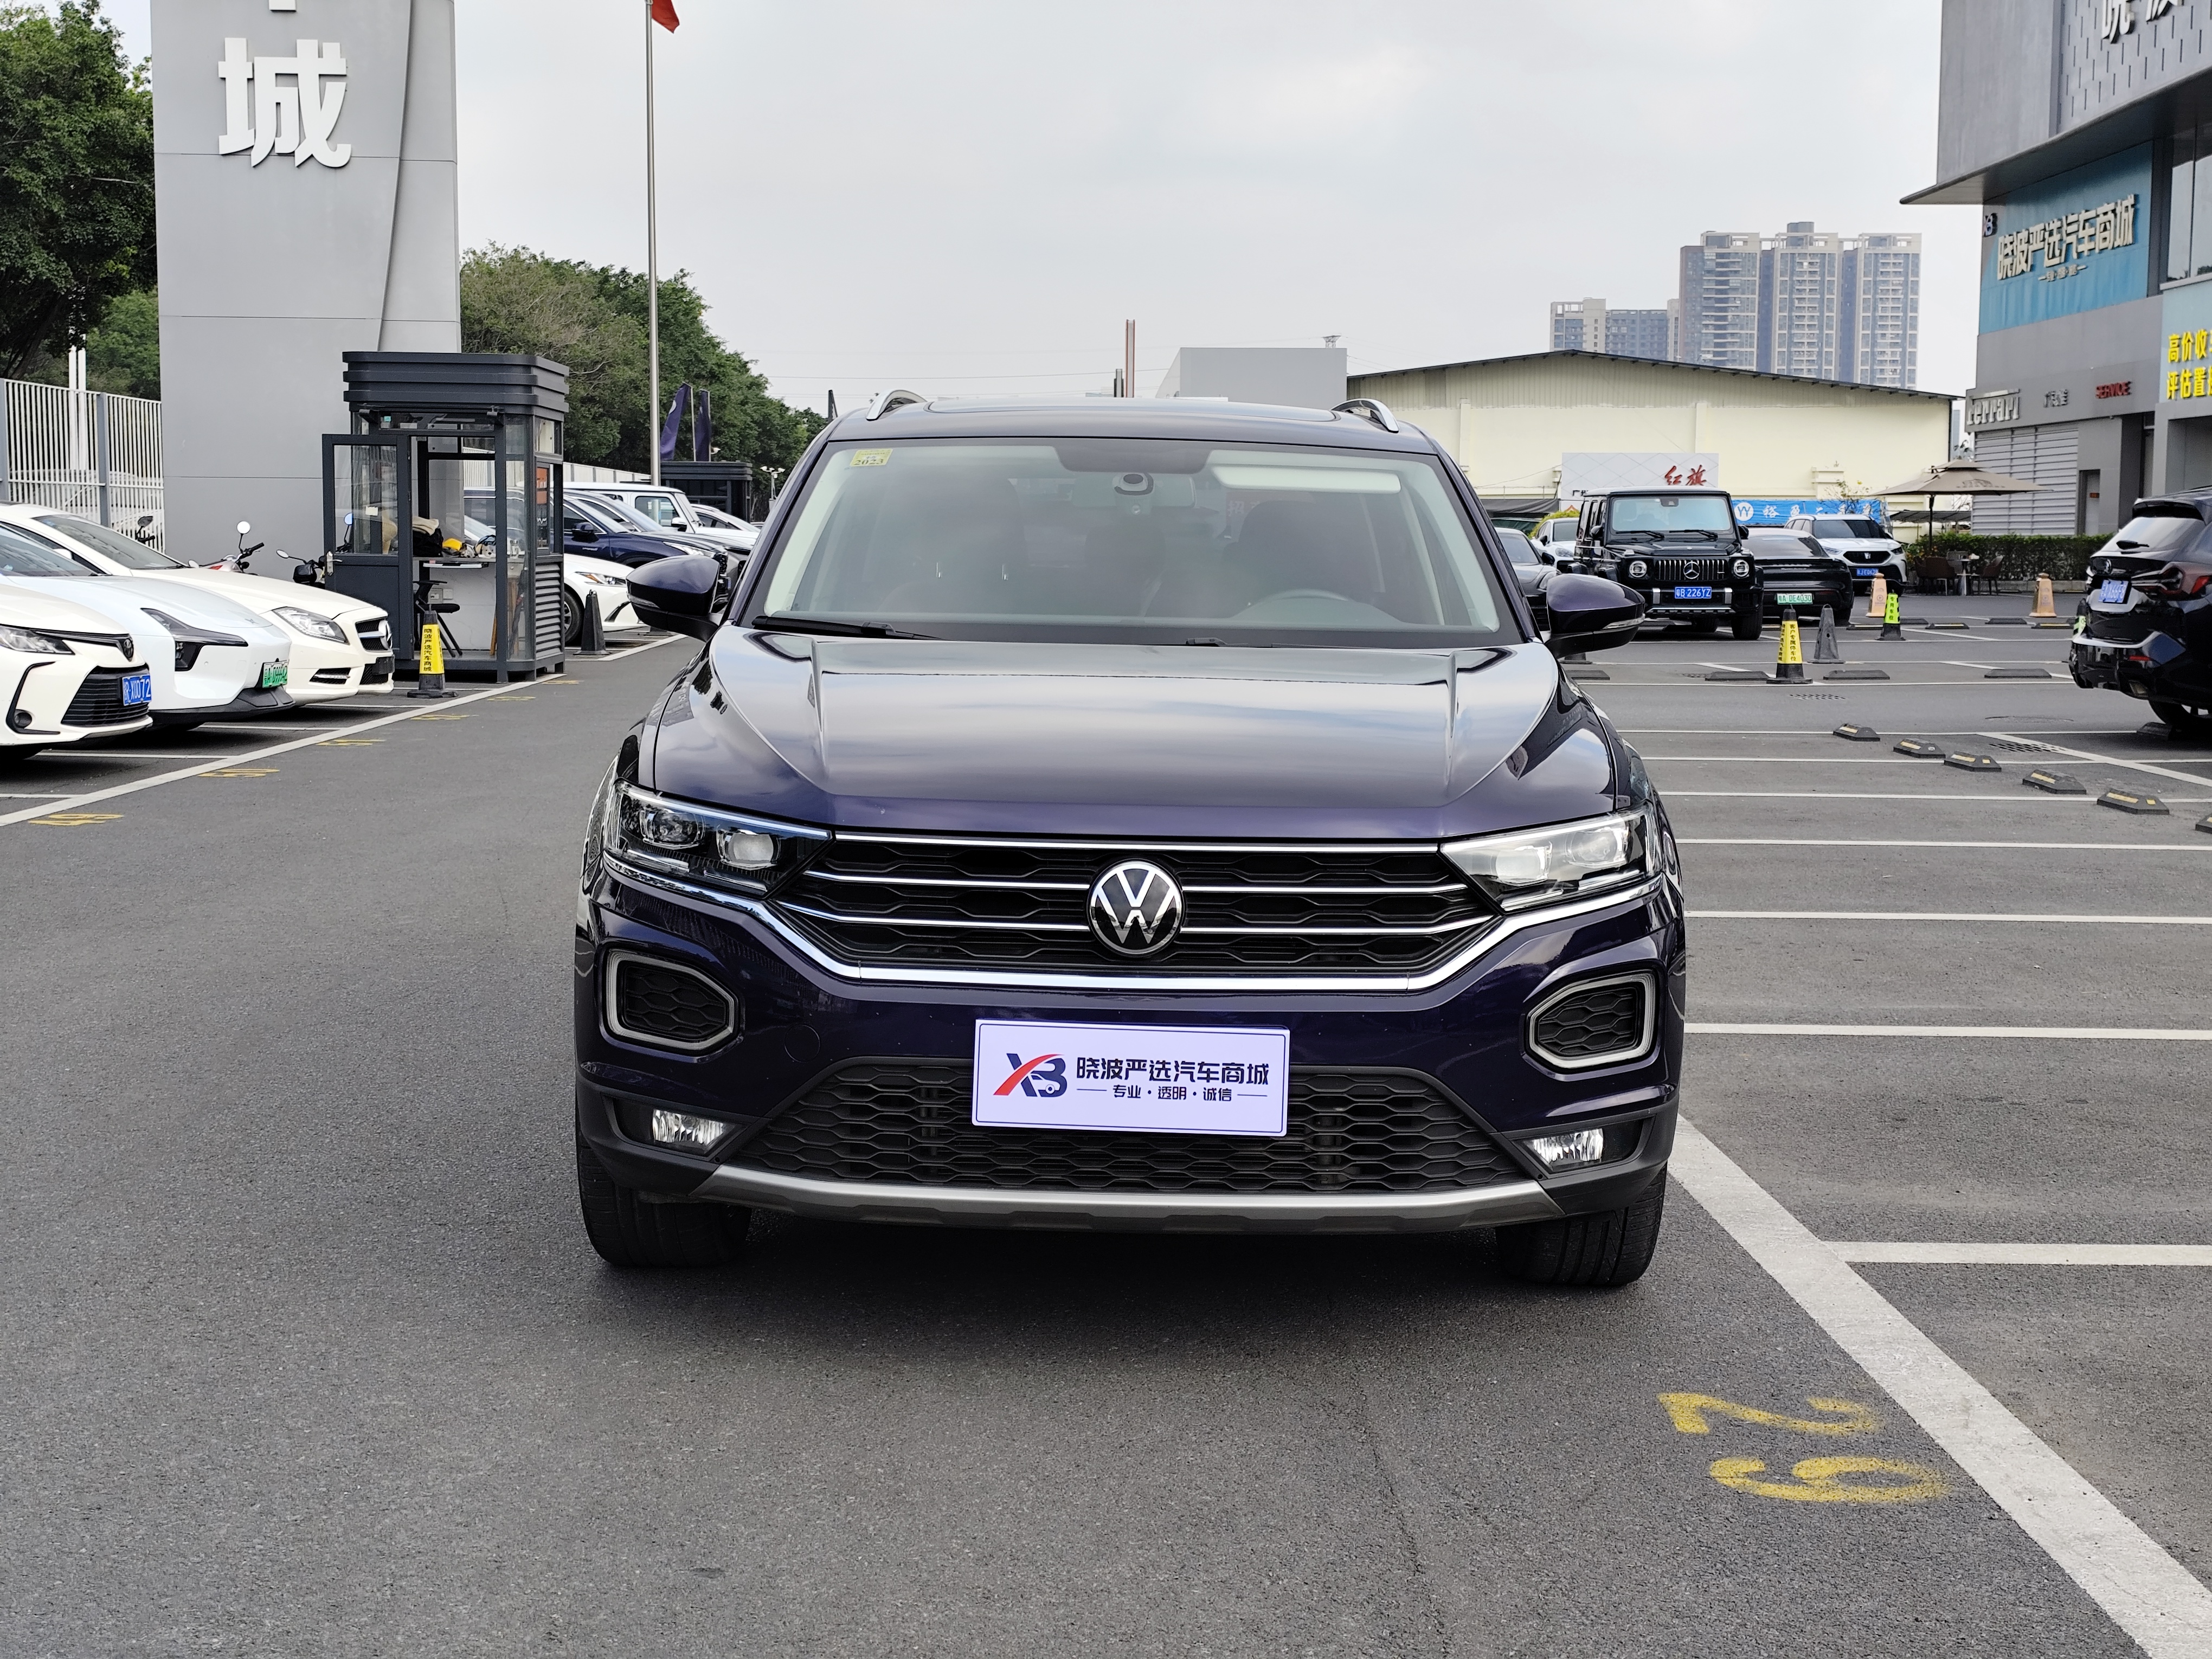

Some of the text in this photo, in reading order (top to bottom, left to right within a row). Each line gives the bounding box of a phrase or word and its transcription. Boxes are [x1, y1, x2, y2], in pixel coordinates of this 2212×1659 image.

[218, 37, 351, 168] 城
[1997, 194, 2134, 280] 晓波严选汽车商城
[1664, 465, 1707, 486] 红旗
[423, 628, 433, 672] 晓波严选汽车商城
[1076, 1057, 1270, 1085] 晓波严选汽车商城
